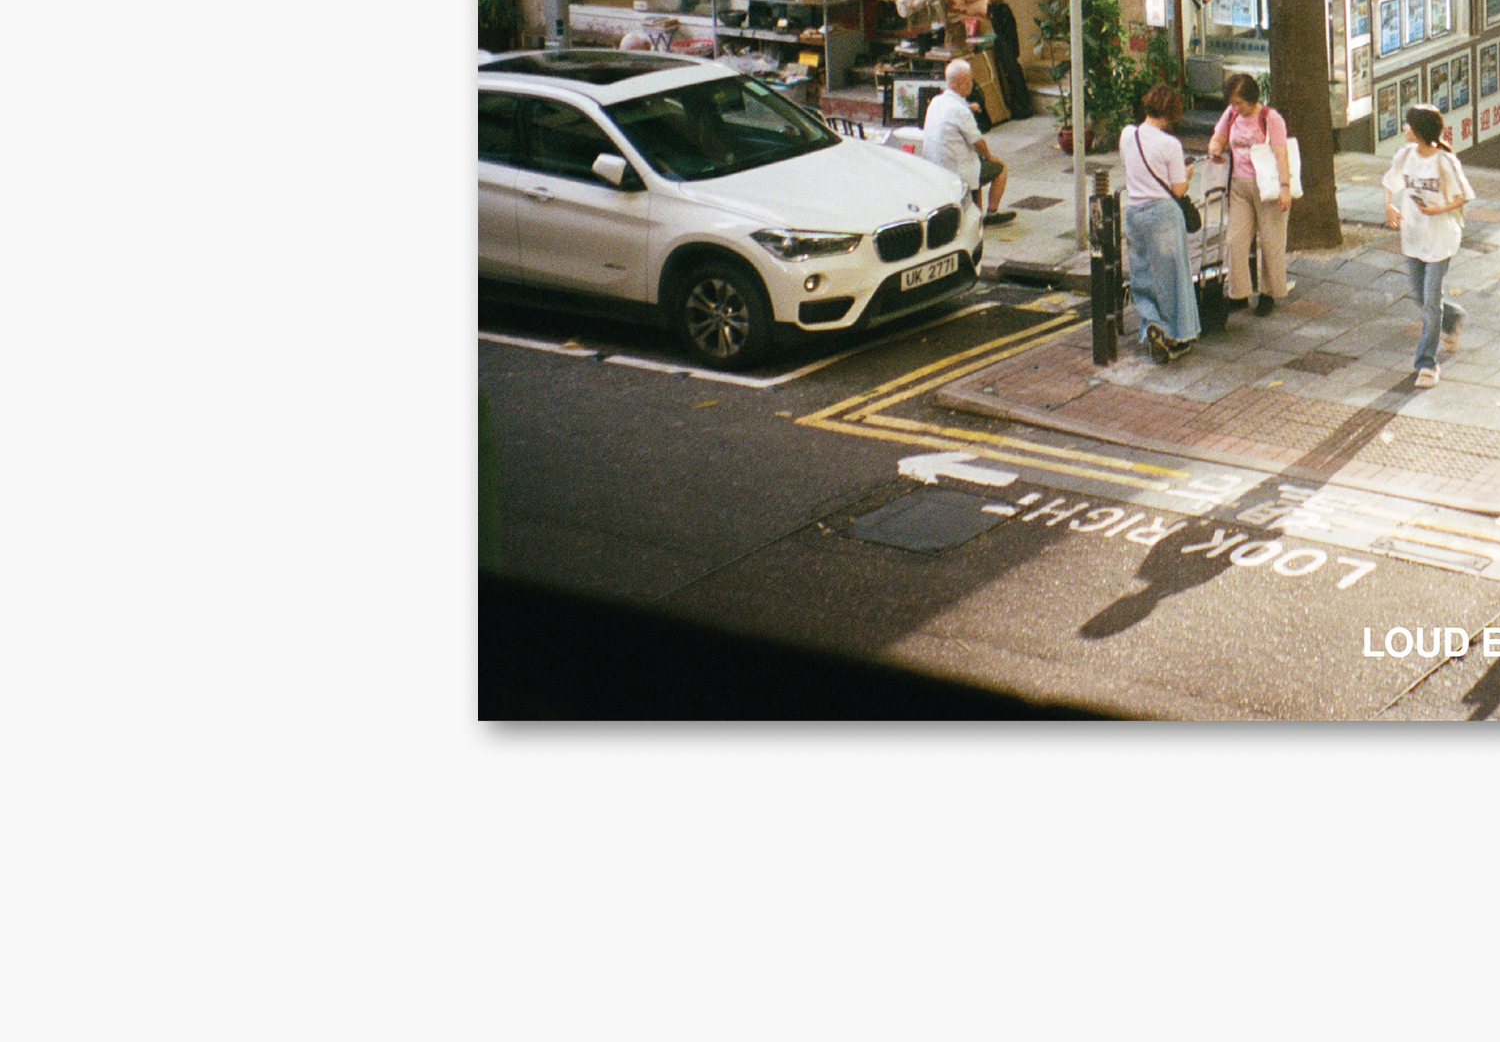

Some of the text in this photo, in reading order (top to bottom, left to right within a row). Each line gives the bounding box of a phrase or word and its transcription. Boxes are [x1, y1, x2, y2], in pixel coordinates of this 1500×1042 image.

[906, 257, 954, 286] UK 2771
[1181, 527, 1378, 590] LOOK
